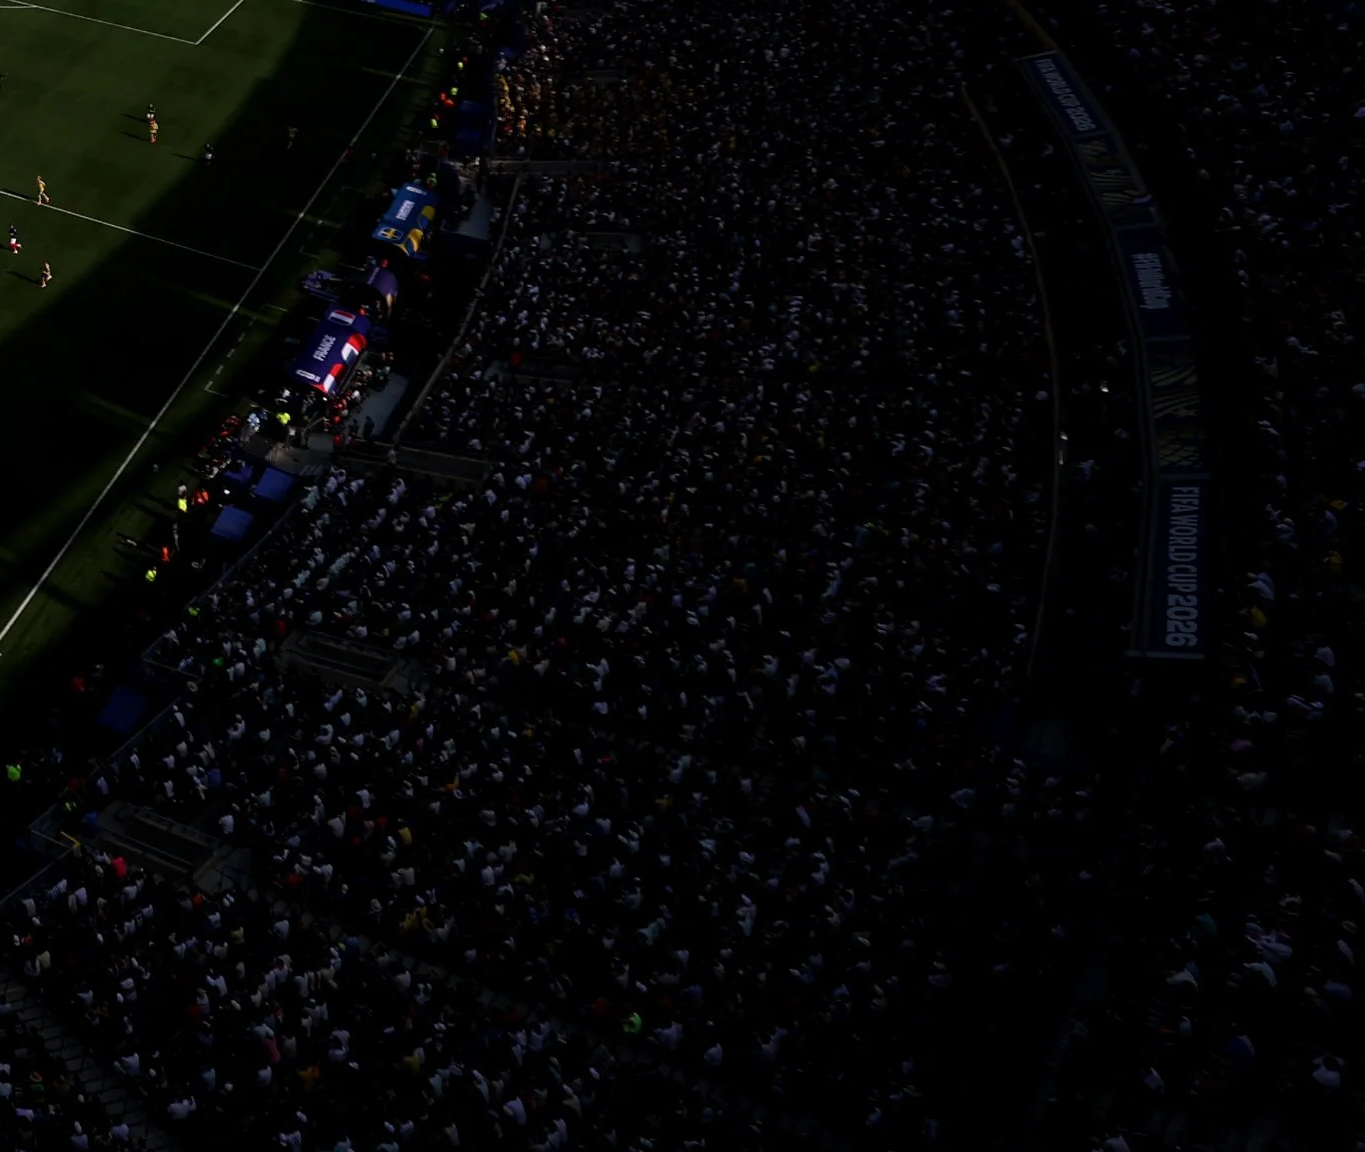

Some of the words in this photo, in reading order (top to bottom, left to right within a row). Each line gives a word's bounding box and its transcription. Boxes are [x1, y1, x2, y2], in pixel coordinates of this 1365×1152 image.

[312, 333, 337, 362] FRANCE
[1169, 485, 1201, 514] FIFA
[1167, 513, 1200, 563] WORLD
[1165, 563, 1199, 593] CUP
[1164, 592, 1199, 648] 2026
